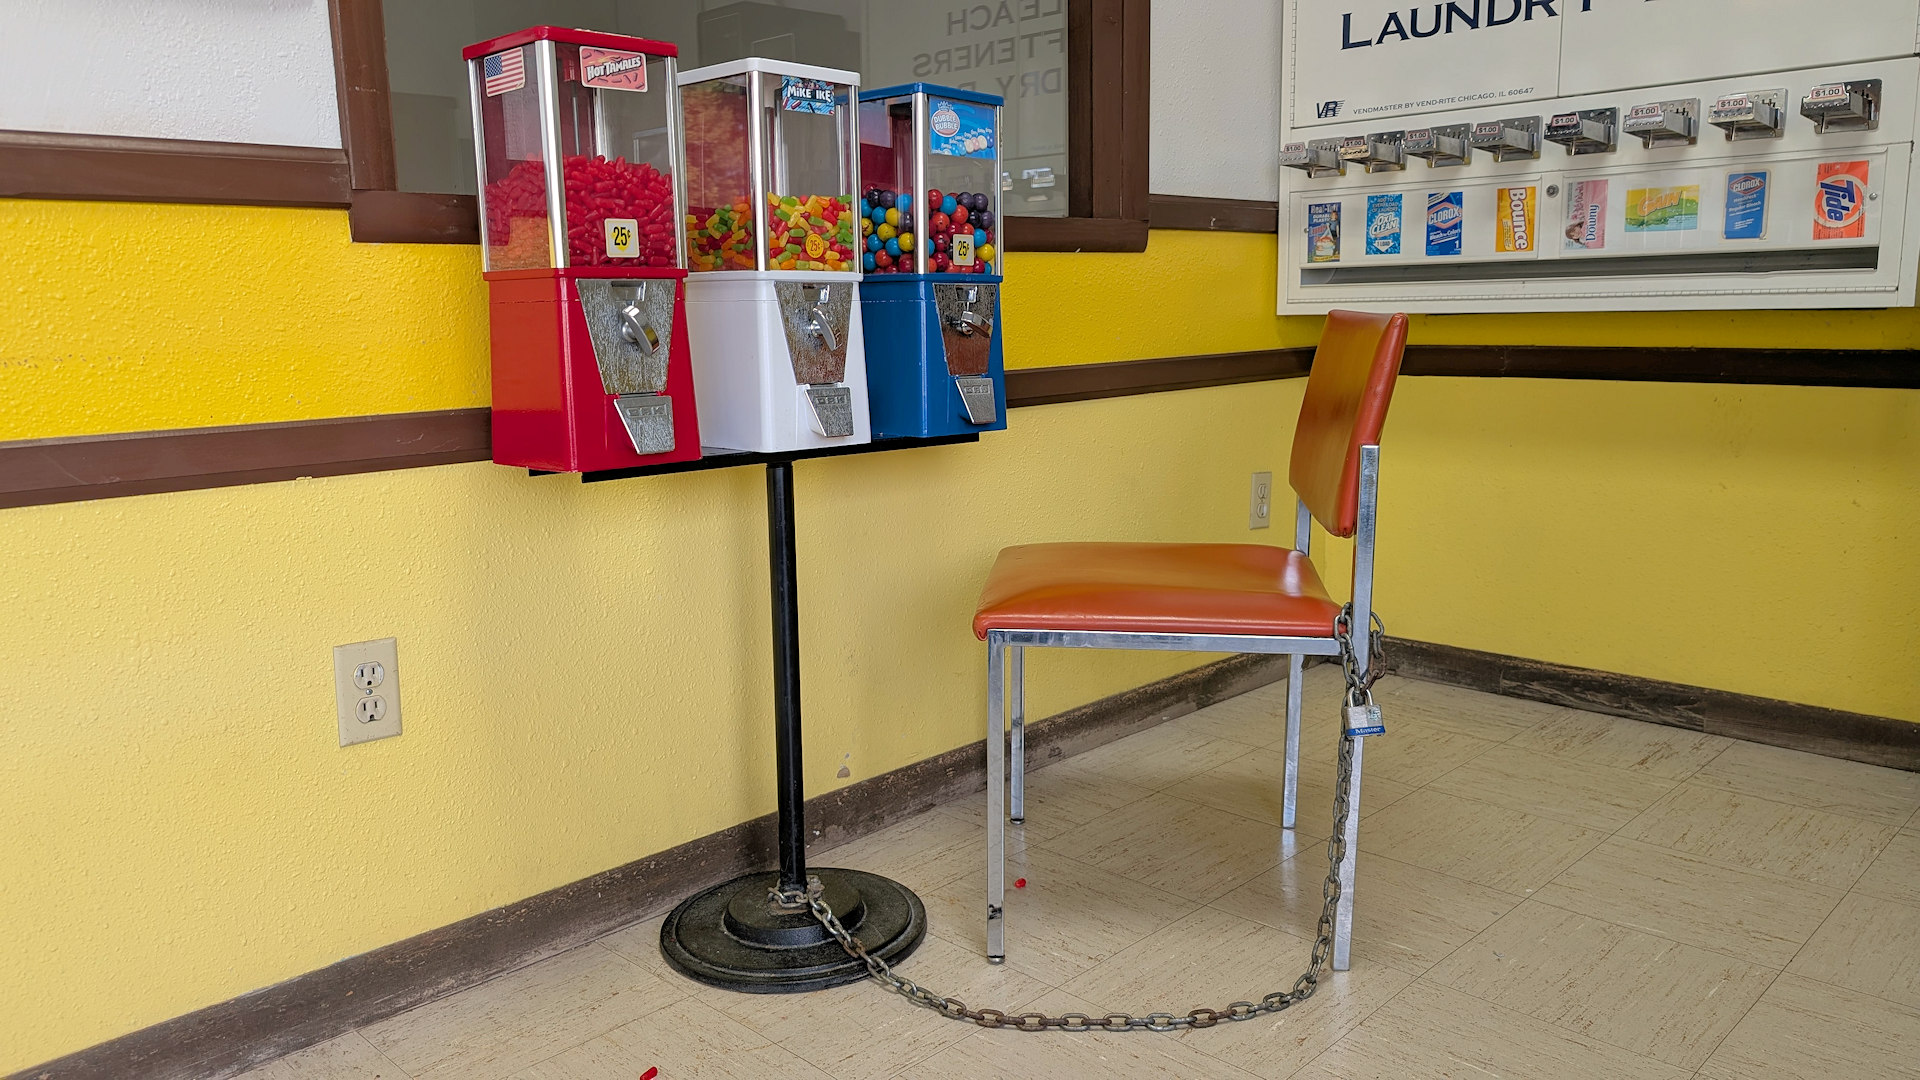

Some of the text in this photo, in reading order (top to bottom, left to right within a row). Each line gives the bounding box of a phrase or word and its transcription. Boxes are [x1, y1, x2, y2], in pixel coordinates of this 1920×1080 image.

[586, 56, 642, 82] HOT TAMALES
[1815, 88, 1840, 97] $1.00
[1353, 104, 1403, 114] VENDMASTER
[1415, 97, 1456, 107] VEND-RITE
[1508, 87, 1535, 96] 60647
[1720, 99, 1744, 108] $1.00
[934, 114, 956, 123] DUBBLE
[1634, 108, 1656, 116] $1.00
[935, 121, 958, 130] BUBBLE
[1554, 117, 1575, 125] $1.00
[1733, 178, 1761, 192] CLOROX
[1820, 180, 1856, 221] Tide
[1508, 187, 1528, 250] Bounce
[1586, 204, 1600, 241] Downy
[613, 226, 631, 246] 25¢
[958, 240, 970, 257] 25¢
[1355, 727, 1381, 735] Master
